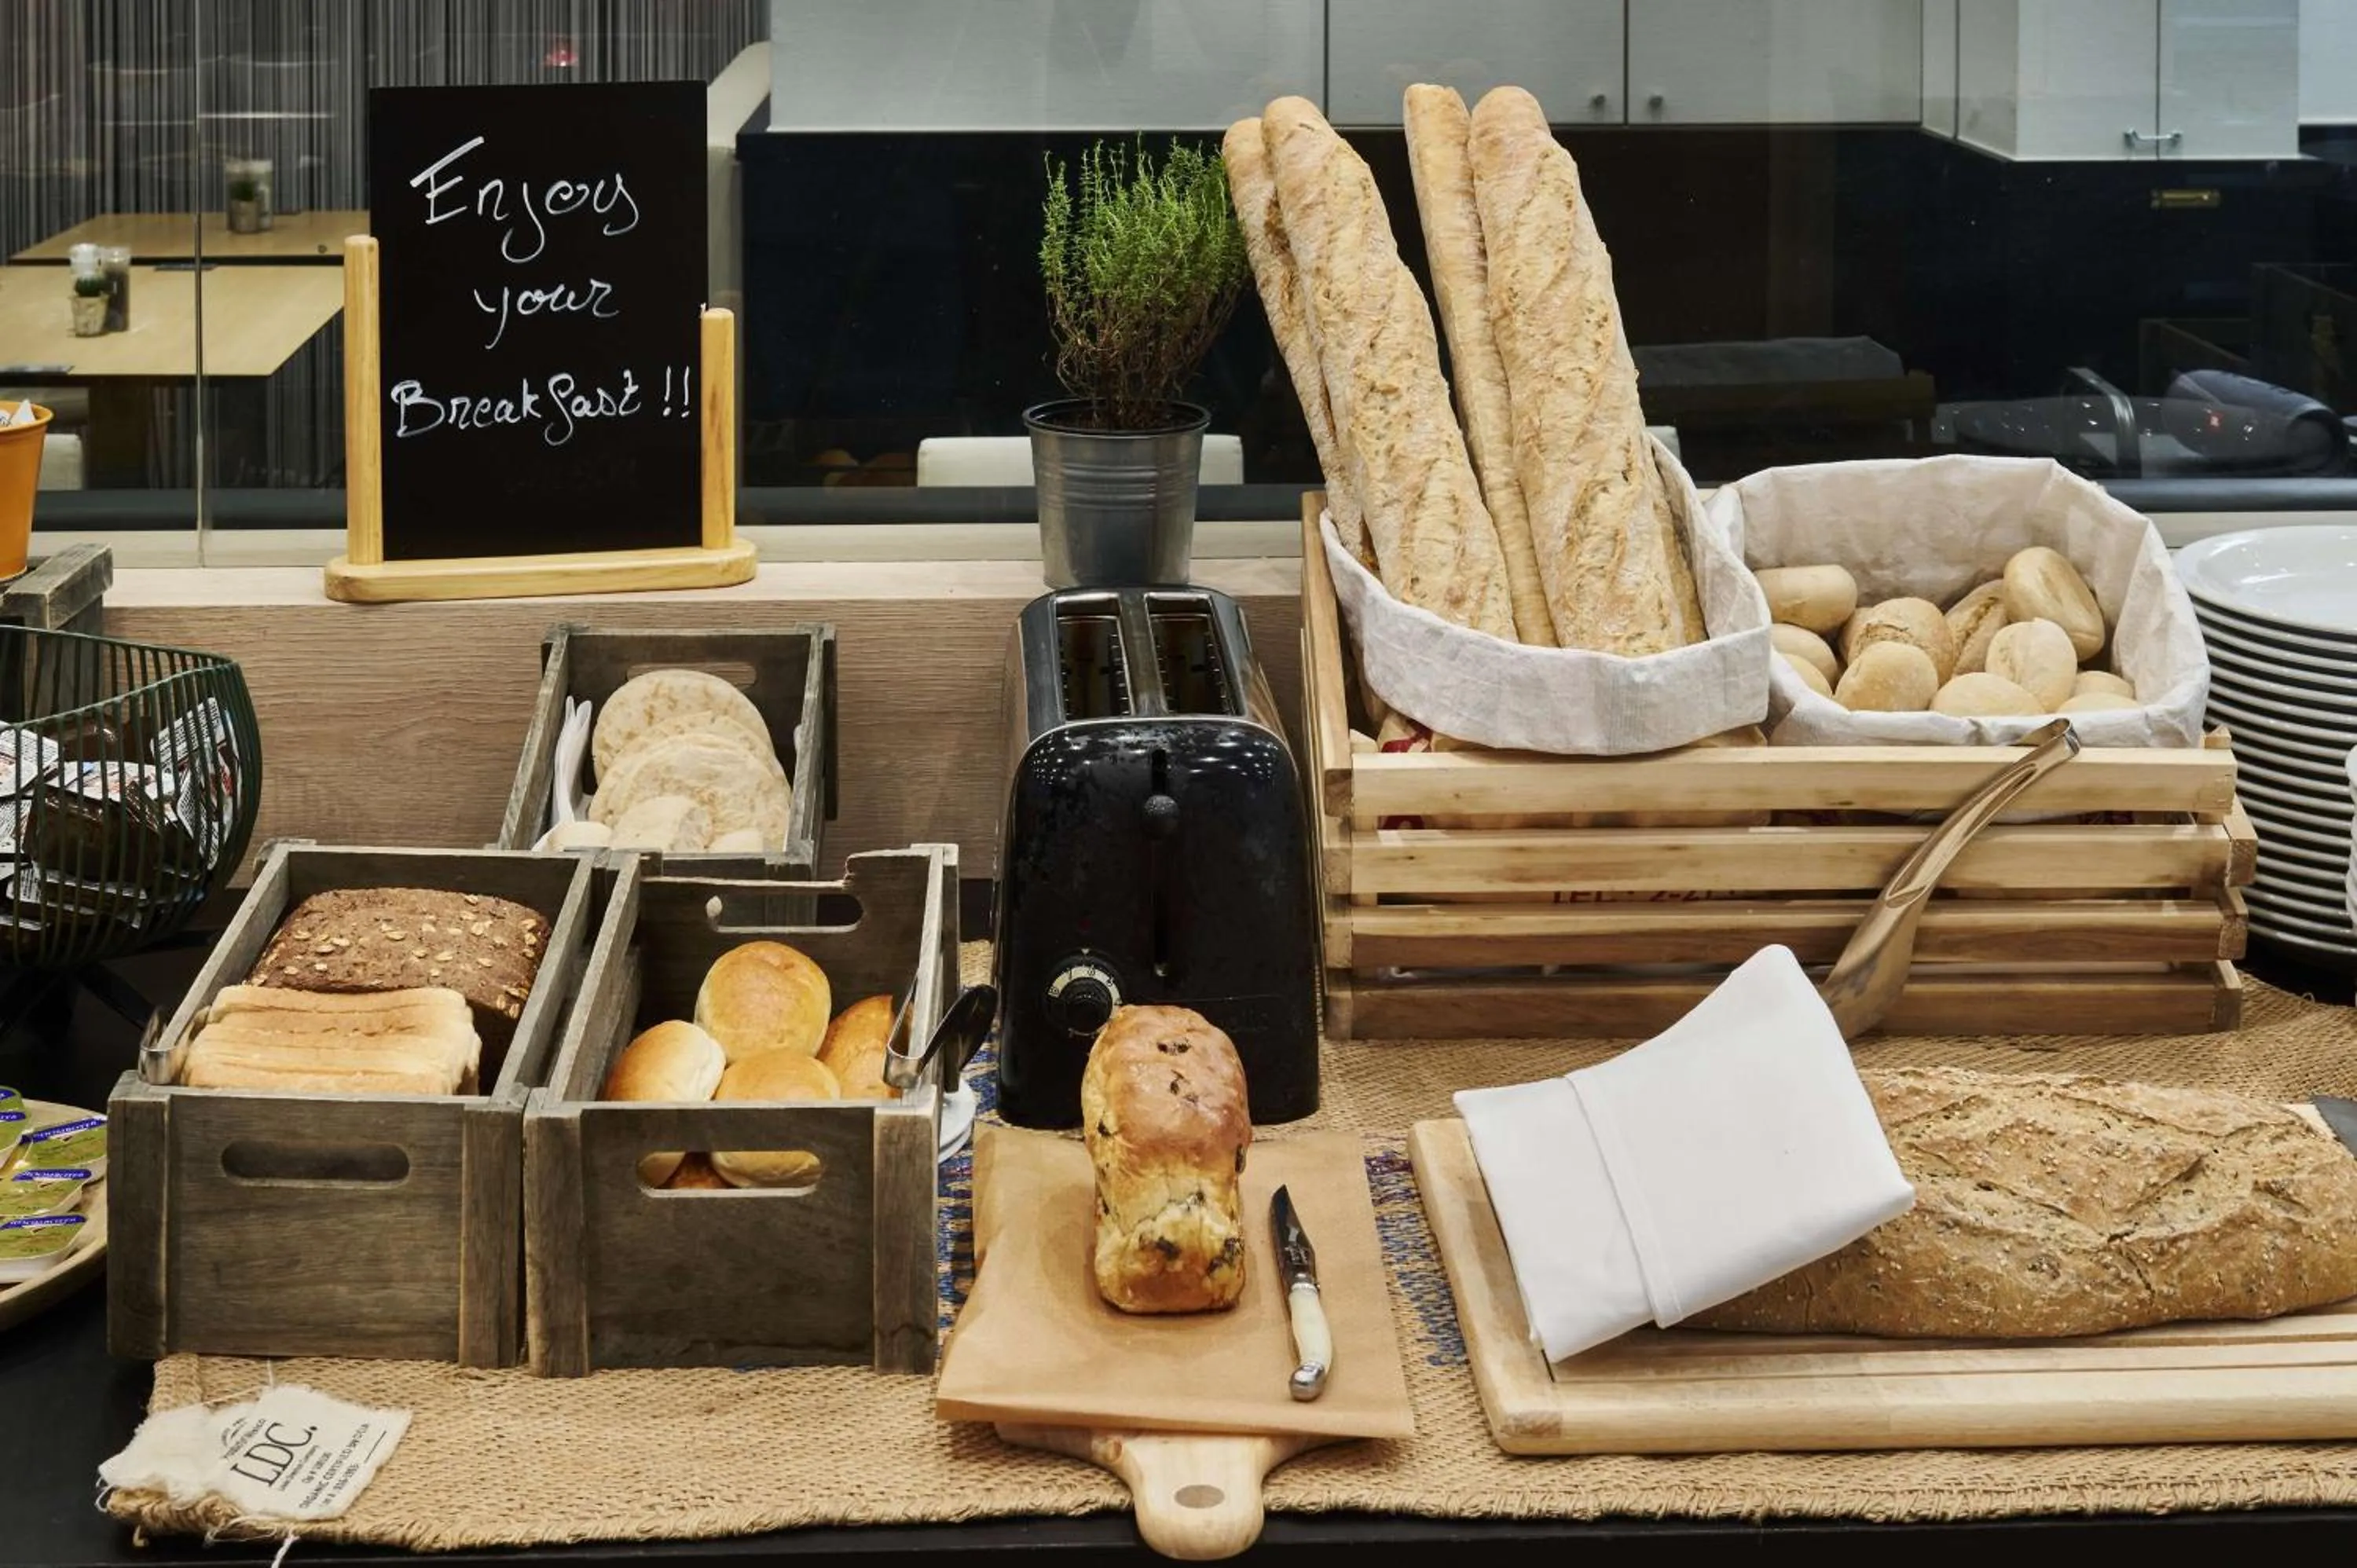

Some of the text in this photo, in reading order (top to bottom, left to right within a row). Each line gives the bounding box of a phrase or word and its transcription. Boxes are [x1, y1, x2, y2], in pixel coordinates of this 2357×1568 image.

[409, 136, 639, 263] Enjoy
[474, 278, 619, 349] your
[391, 369, 641, 445] Breakfast
